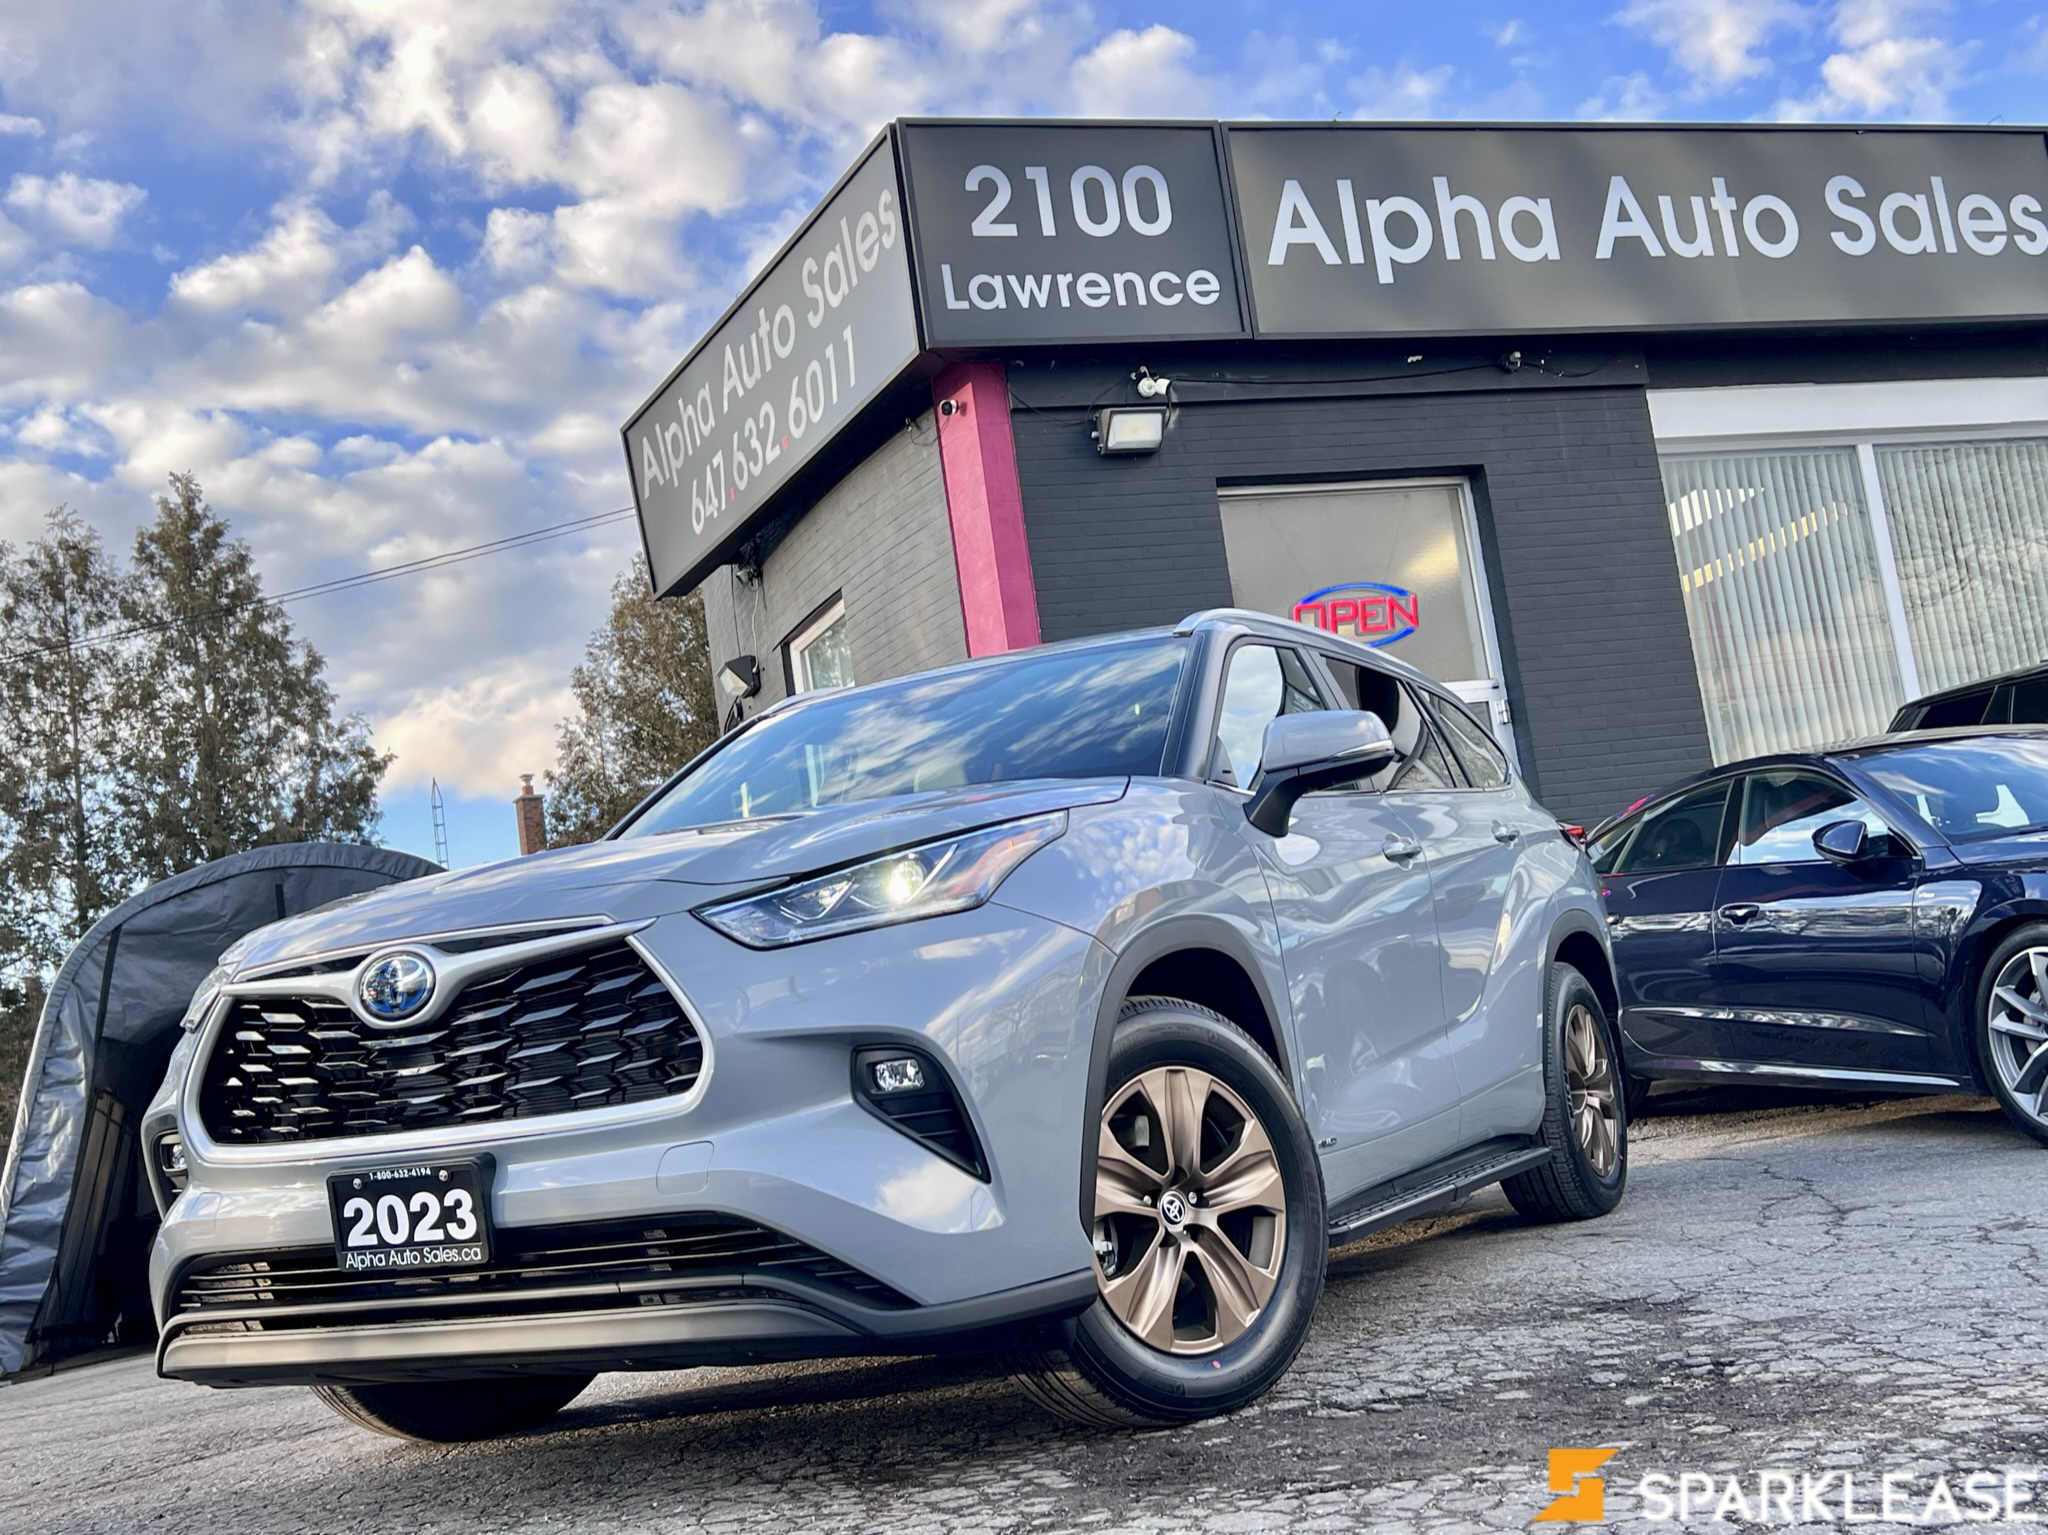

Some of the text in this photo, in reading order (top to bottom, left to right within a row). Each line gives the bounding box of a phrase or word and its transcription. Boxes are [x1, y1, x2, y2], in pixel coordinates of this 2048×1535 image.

[964, 164, 1173, 238] 2100
[1267, 174, 2048, 285] Alpha Auto Sales
[940, 263, 1222, 310] Lawrence
[641, 189, 897, 500] Alpha Auto Sales
[690, 324, 857, 535] 647.632.6011
[343, 1188, 478, 1247] 2023
[346, 1246, 482, 1271] Alpha Auto Sales.ca
